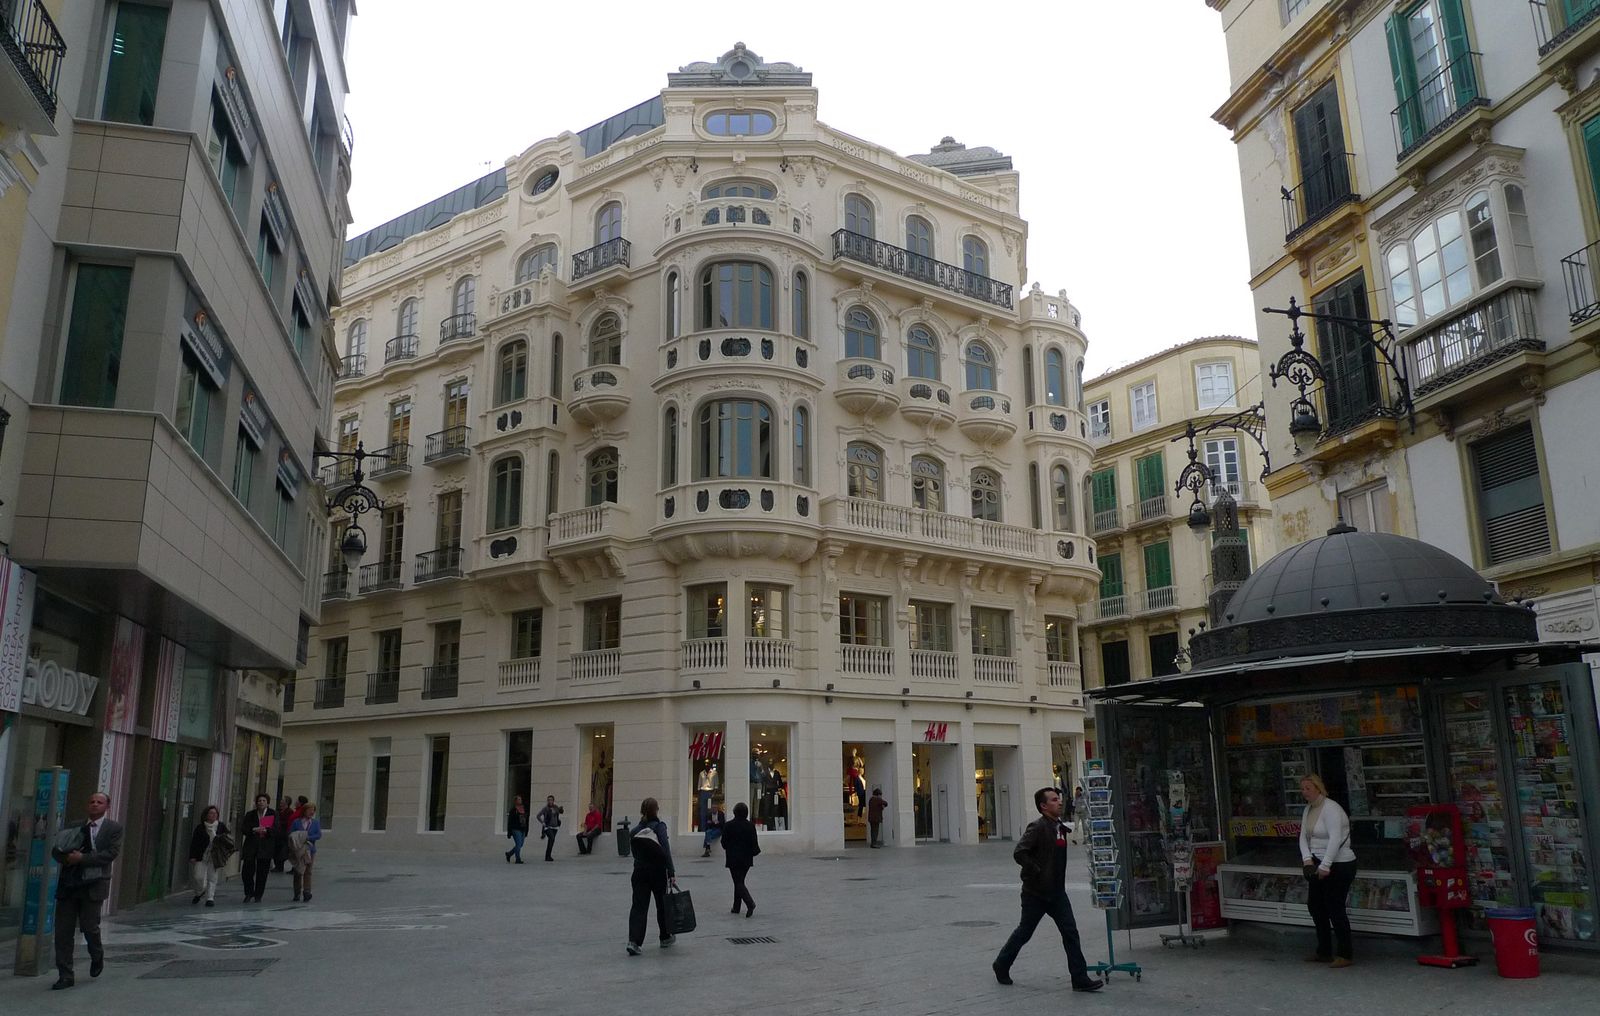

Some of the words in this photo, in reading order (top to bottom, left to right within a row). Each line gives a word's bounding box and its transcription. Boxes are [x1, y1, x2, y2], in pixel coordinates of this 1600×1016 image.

[3, 571, 26, 708] COMPLEMENTOS
[689, 730, 722, 760] H&M
[923, 722, 948, 742] H&M
